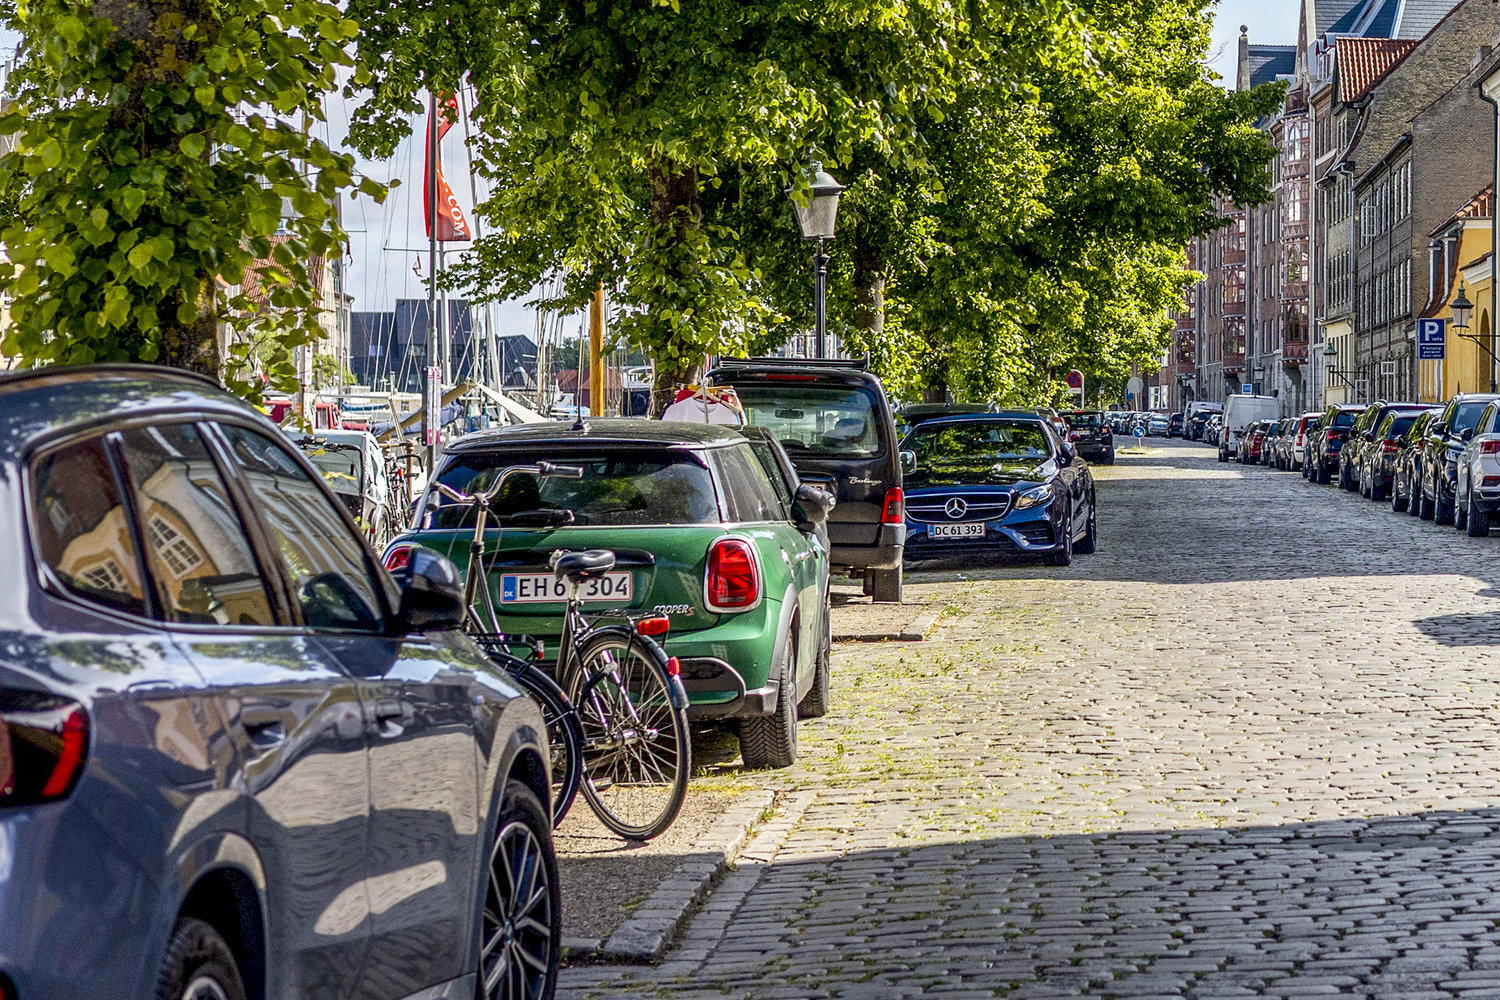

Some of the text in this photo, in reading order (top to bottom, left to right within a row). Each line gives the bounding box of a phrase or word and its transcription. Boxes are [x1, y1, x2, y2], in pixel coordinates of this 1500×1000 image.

[1425, 322, 1439, 341] P
[849, 476, 882, 487] Berlingo
[935, 525, 983, 536] DC 61 393
[518, 578, 547, 598] EH
[586, 576, 628, 597] 304
[504, 590, 513, 598] DK
[653, 604, 689, 615] COOPER
